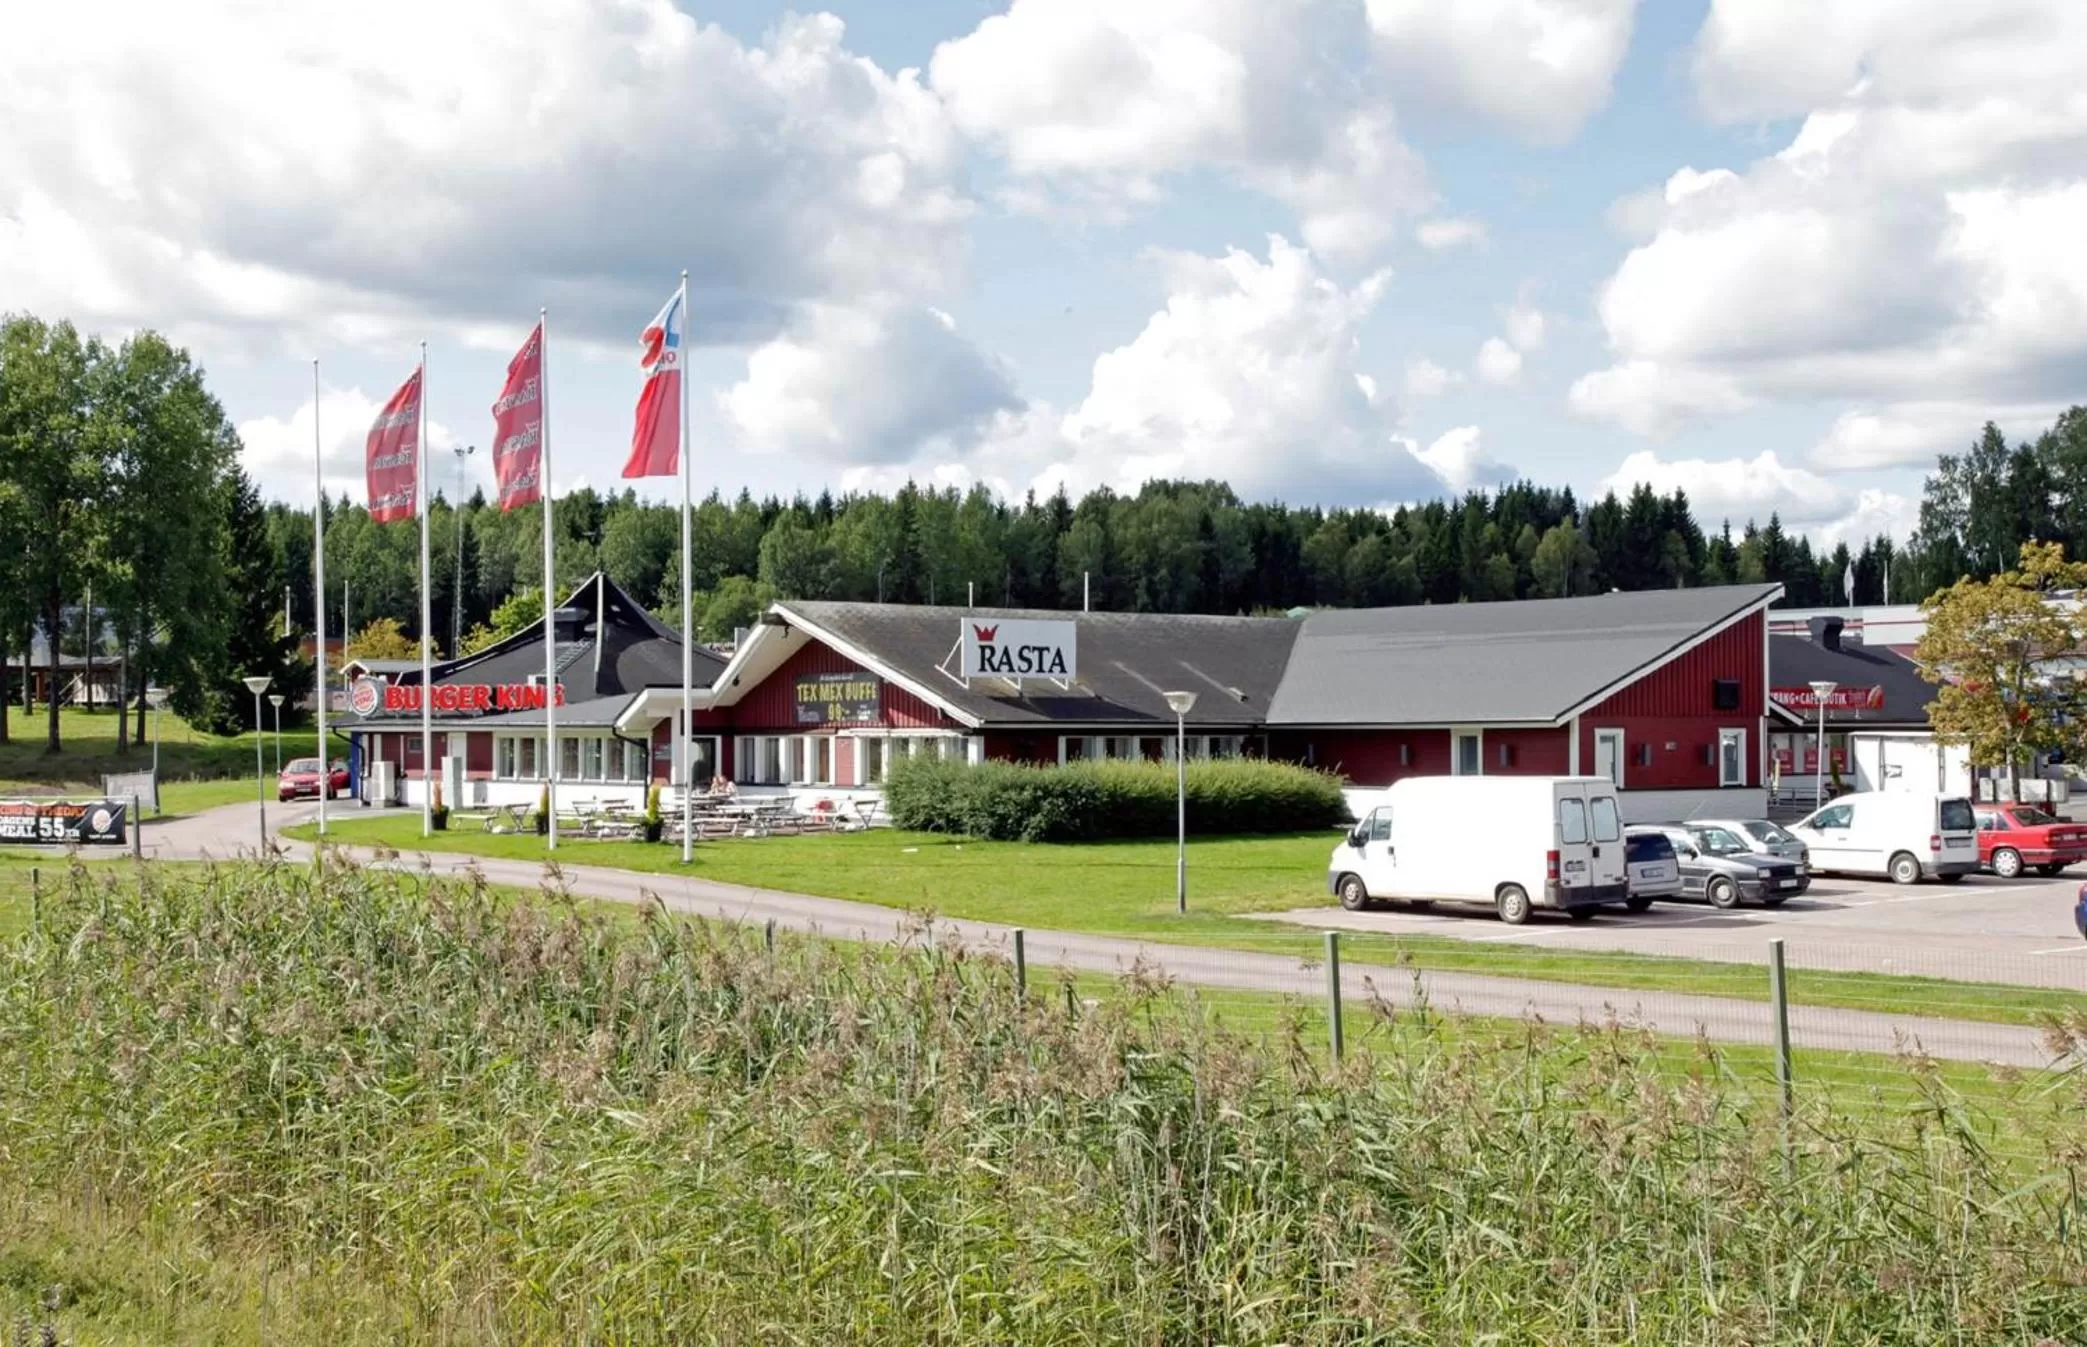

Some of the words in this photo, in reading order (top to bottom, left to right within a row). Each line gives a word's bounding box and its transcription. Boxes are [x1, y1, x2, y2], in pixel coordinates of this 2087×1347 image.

[978, 645, 1068, 674] RASTA
[384, 683, 492, 711] BURGER
[797, 683, 817, 702] TEX
[820, 682, 844, 702] MEX
[39, 817, 65, 838] 55
